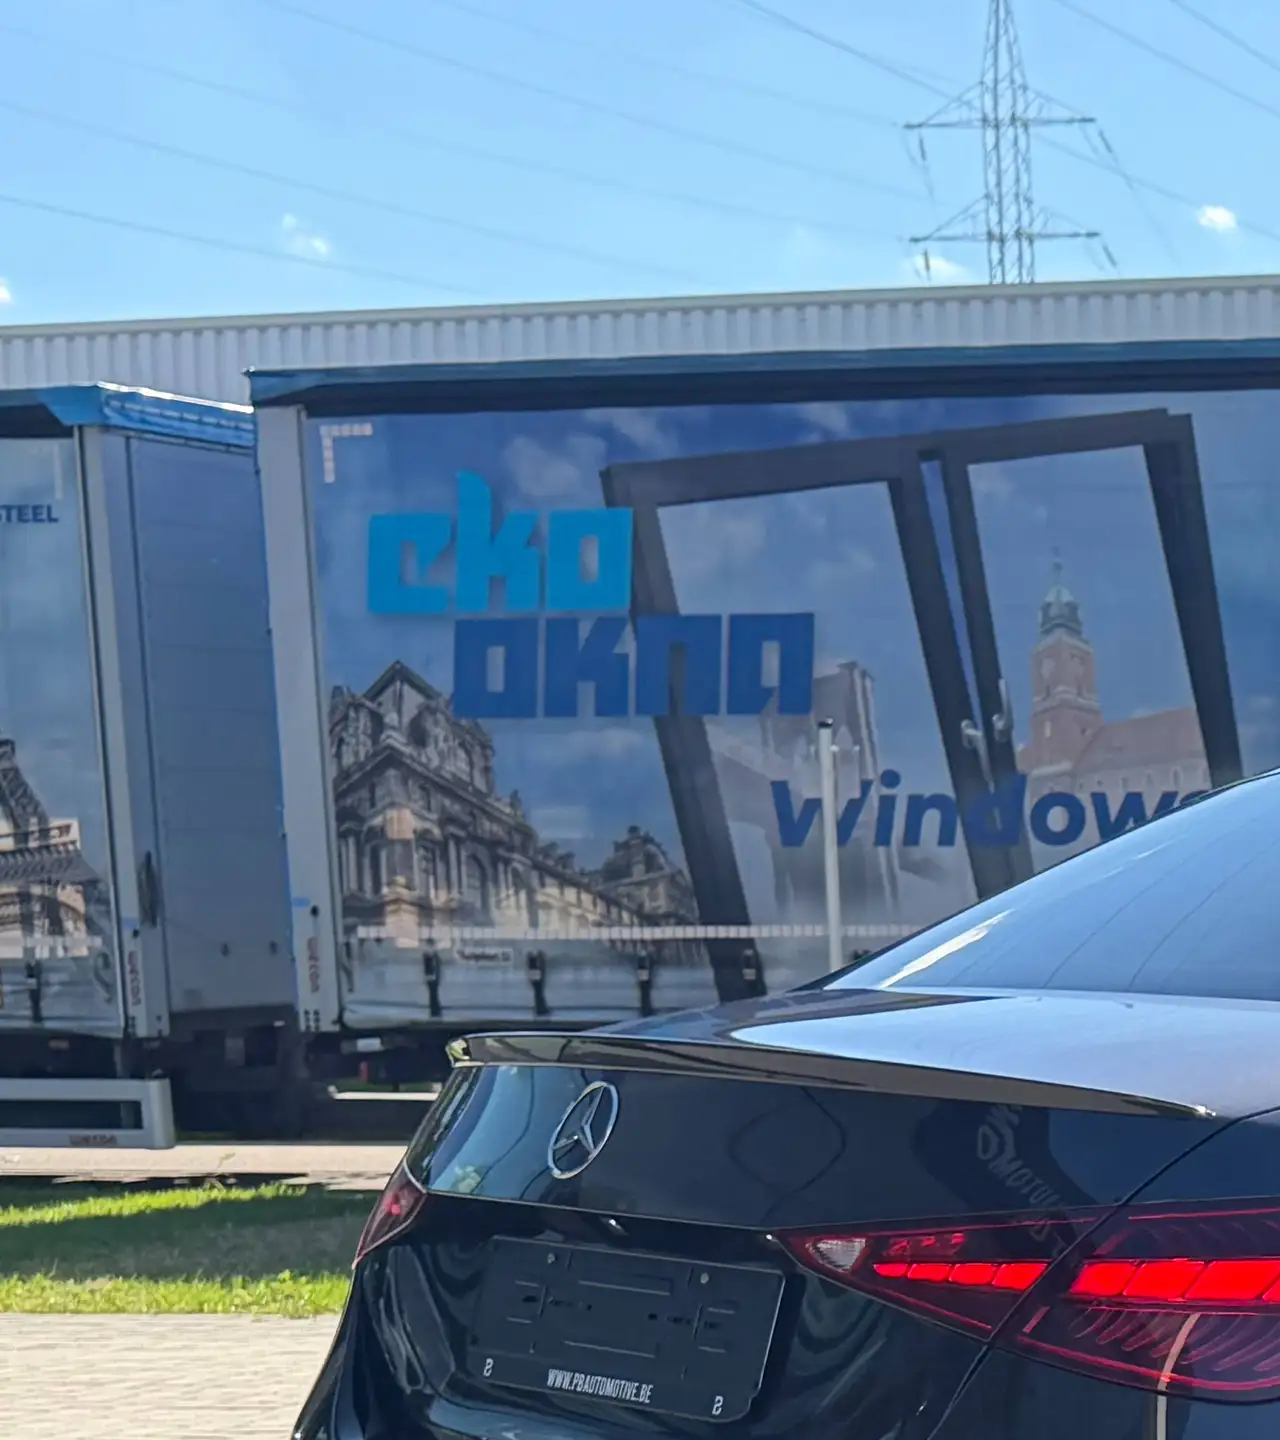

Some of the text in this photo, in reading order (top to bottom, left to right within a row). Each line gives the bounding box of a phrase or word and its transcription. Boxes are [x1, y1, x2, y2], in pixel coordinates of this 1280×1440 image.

[0, 504, 60, 524] TEEL
[770, 769, 1222, 847] Window
[547, 1368, 654, 1404] WWW.PBAUTOMOTIVE.BE
